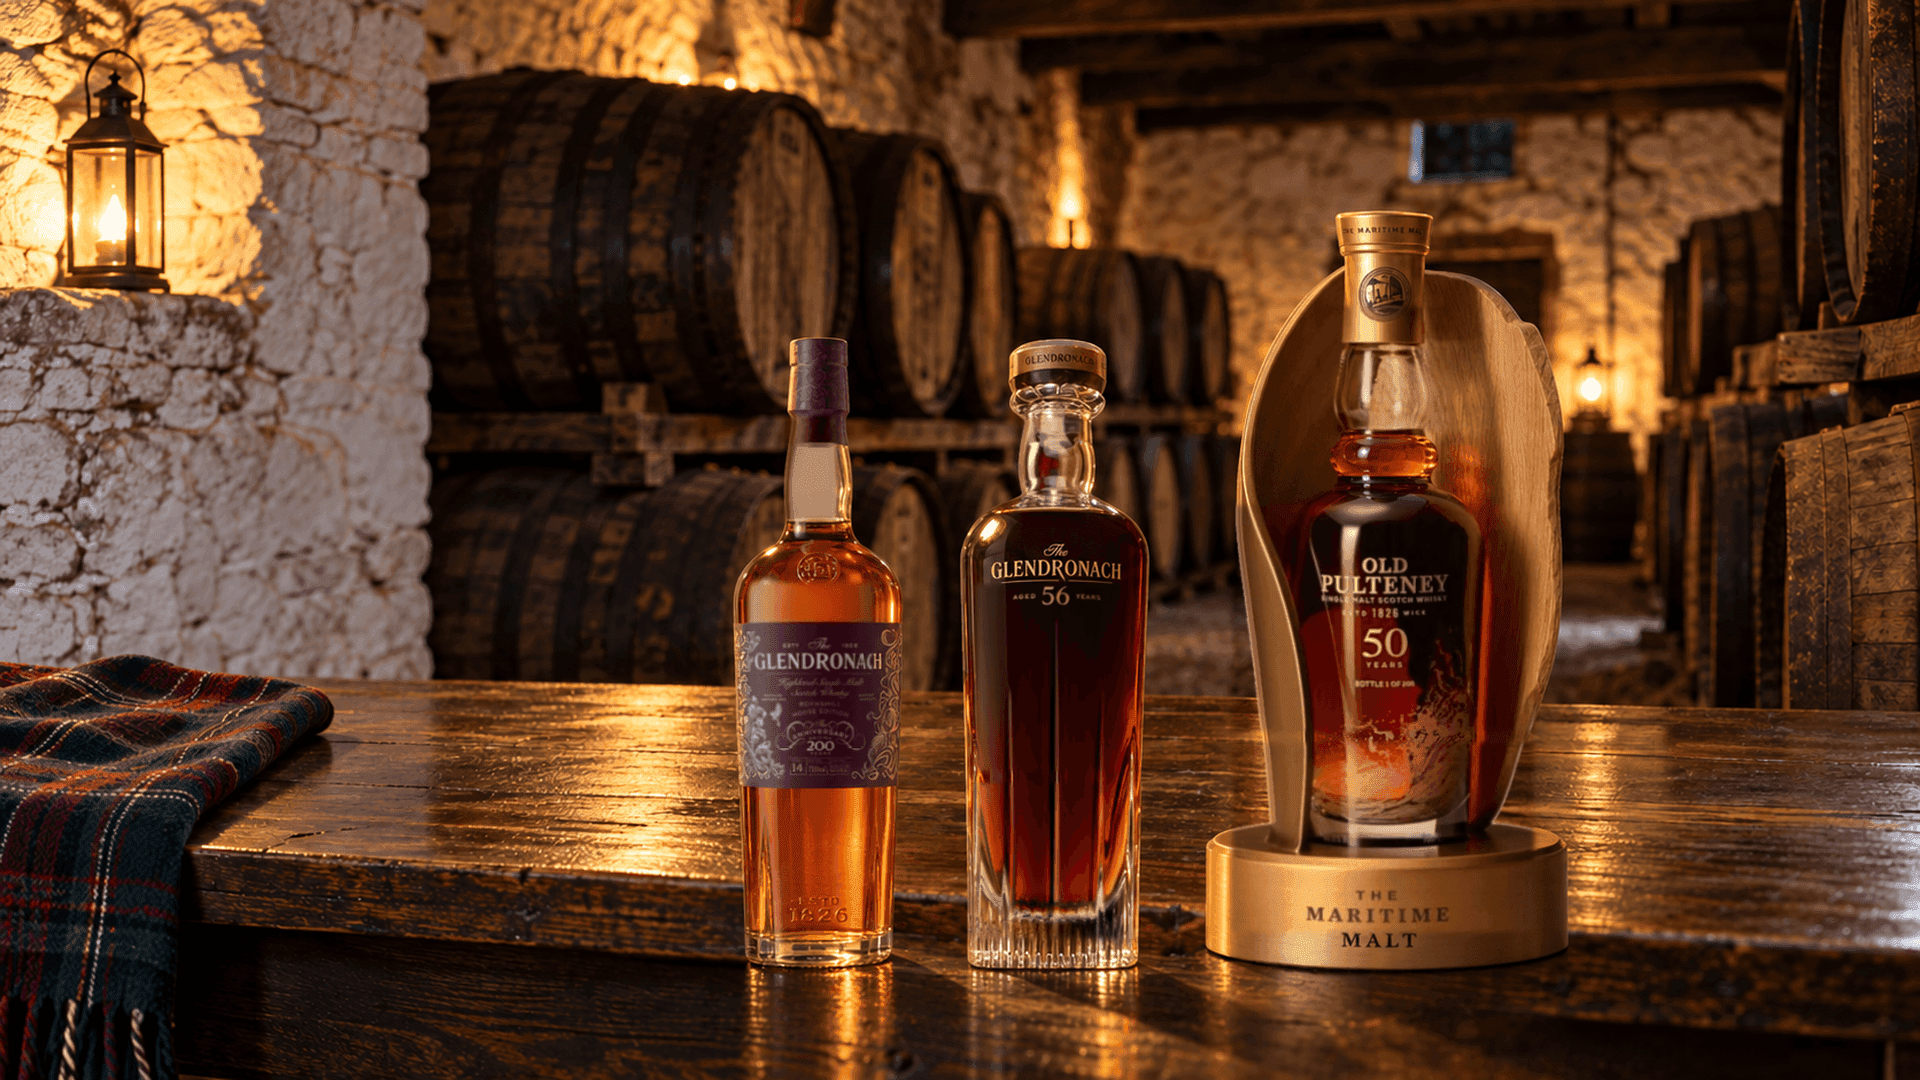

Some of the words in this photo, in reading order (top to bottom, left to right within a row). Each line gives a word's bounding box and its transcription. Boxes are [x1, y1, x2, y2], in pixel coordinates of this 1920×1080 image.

[1357, 226, 1405, 234] MARITIME
[1408, 227, 1425, 235] MAL
[1043, 542, 1069, 557] The
[990, 558, 1122, 582] GLENDRONACH
[1361, 557, 1408, 574] OLD
[1320, 573, 1450, 595] PULTENEY
[1012, 592, 1037, 601] AGED
[1041, 585, 1071, 606] 56
[1075, 592, 1102, 601] YEARS
[1377, 596, 1414, 604] SCOTCH
[1416, 594, 1448, 603] WHISKY
[1372, 607, 1399, 618] 1826
[1402, 609, 1427, 617] WICK
[807, 636, 832, 651] The
[1361, 627, 1409, 659] 50
[754, 651, 883, 672] GLENDRONACH
[1365, 660, 1404, 669] YEARS
[1354, 680, 1384, 688] BOTTLE
[806, 740, 835, 752] 200
[792, 762, 804, 773] 14
[1355, 889, 1398, 901] THE
[789, 907, 848, 923] 1826
[1305, 905, 1450, 923] MARITIME
[1340, 931, 1418, 949] MALT
